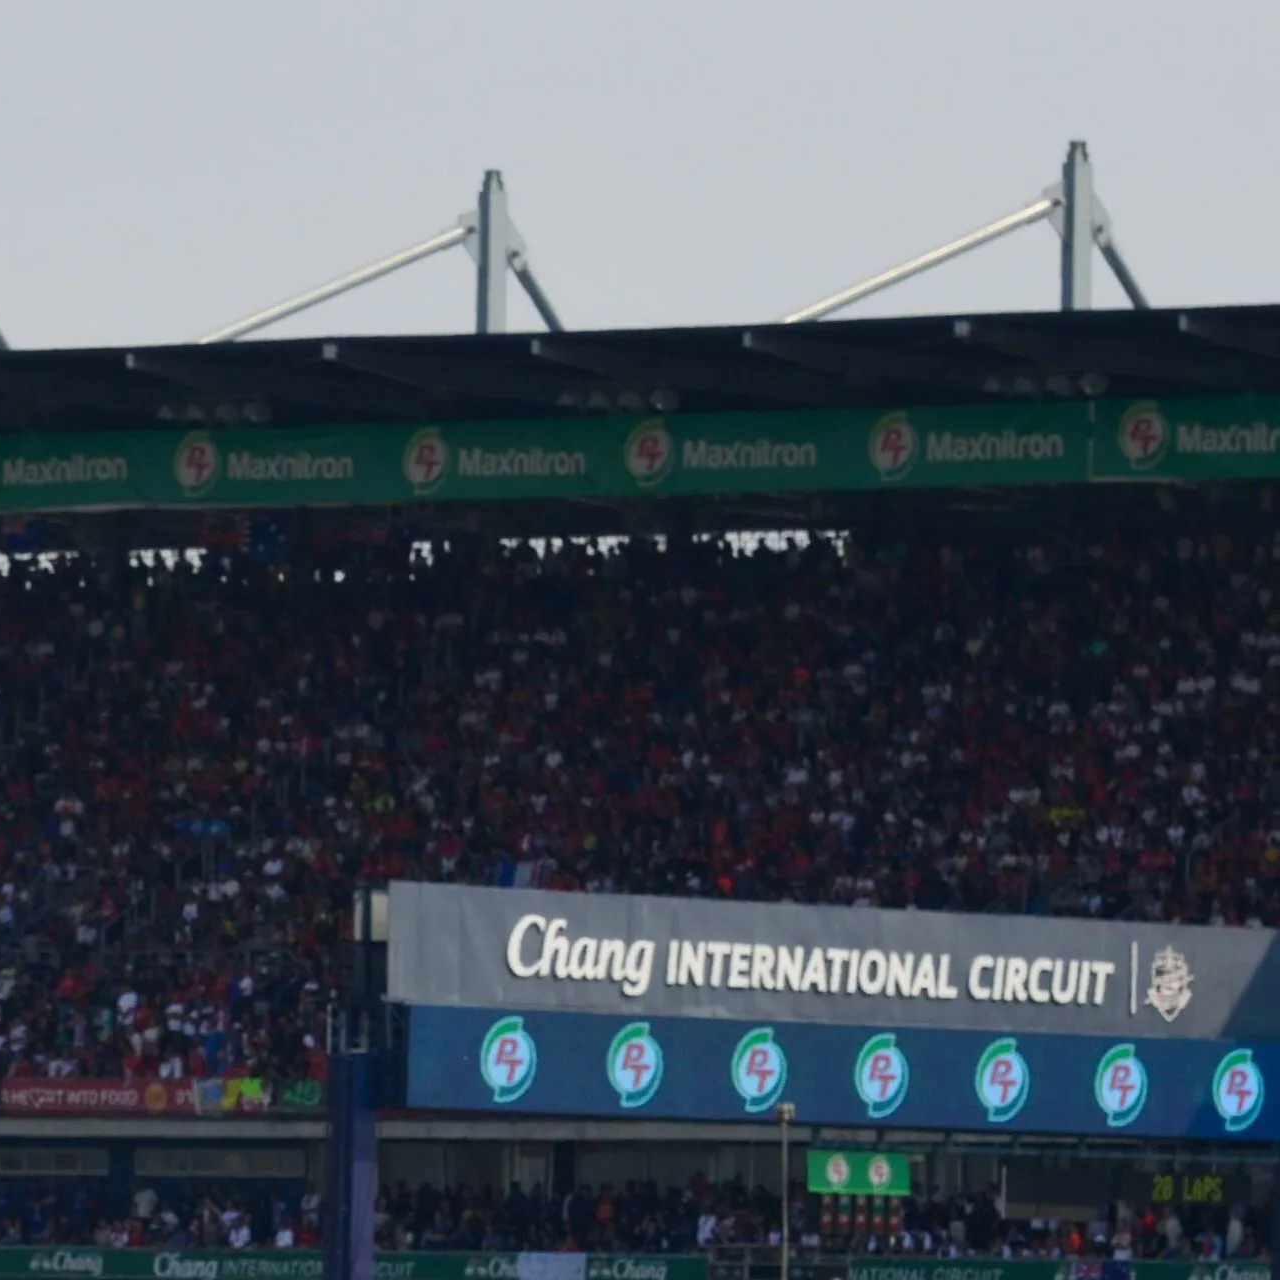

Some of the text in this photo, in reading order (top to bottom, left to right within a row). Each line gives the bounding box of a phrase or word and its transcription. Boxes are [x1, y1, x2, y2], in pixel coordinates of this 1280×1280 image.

[506, 912, 1116, 1006] Chang INTERNATIONAL CIRCUIT
[1182, 1174, 1223, 1202] LAPS
